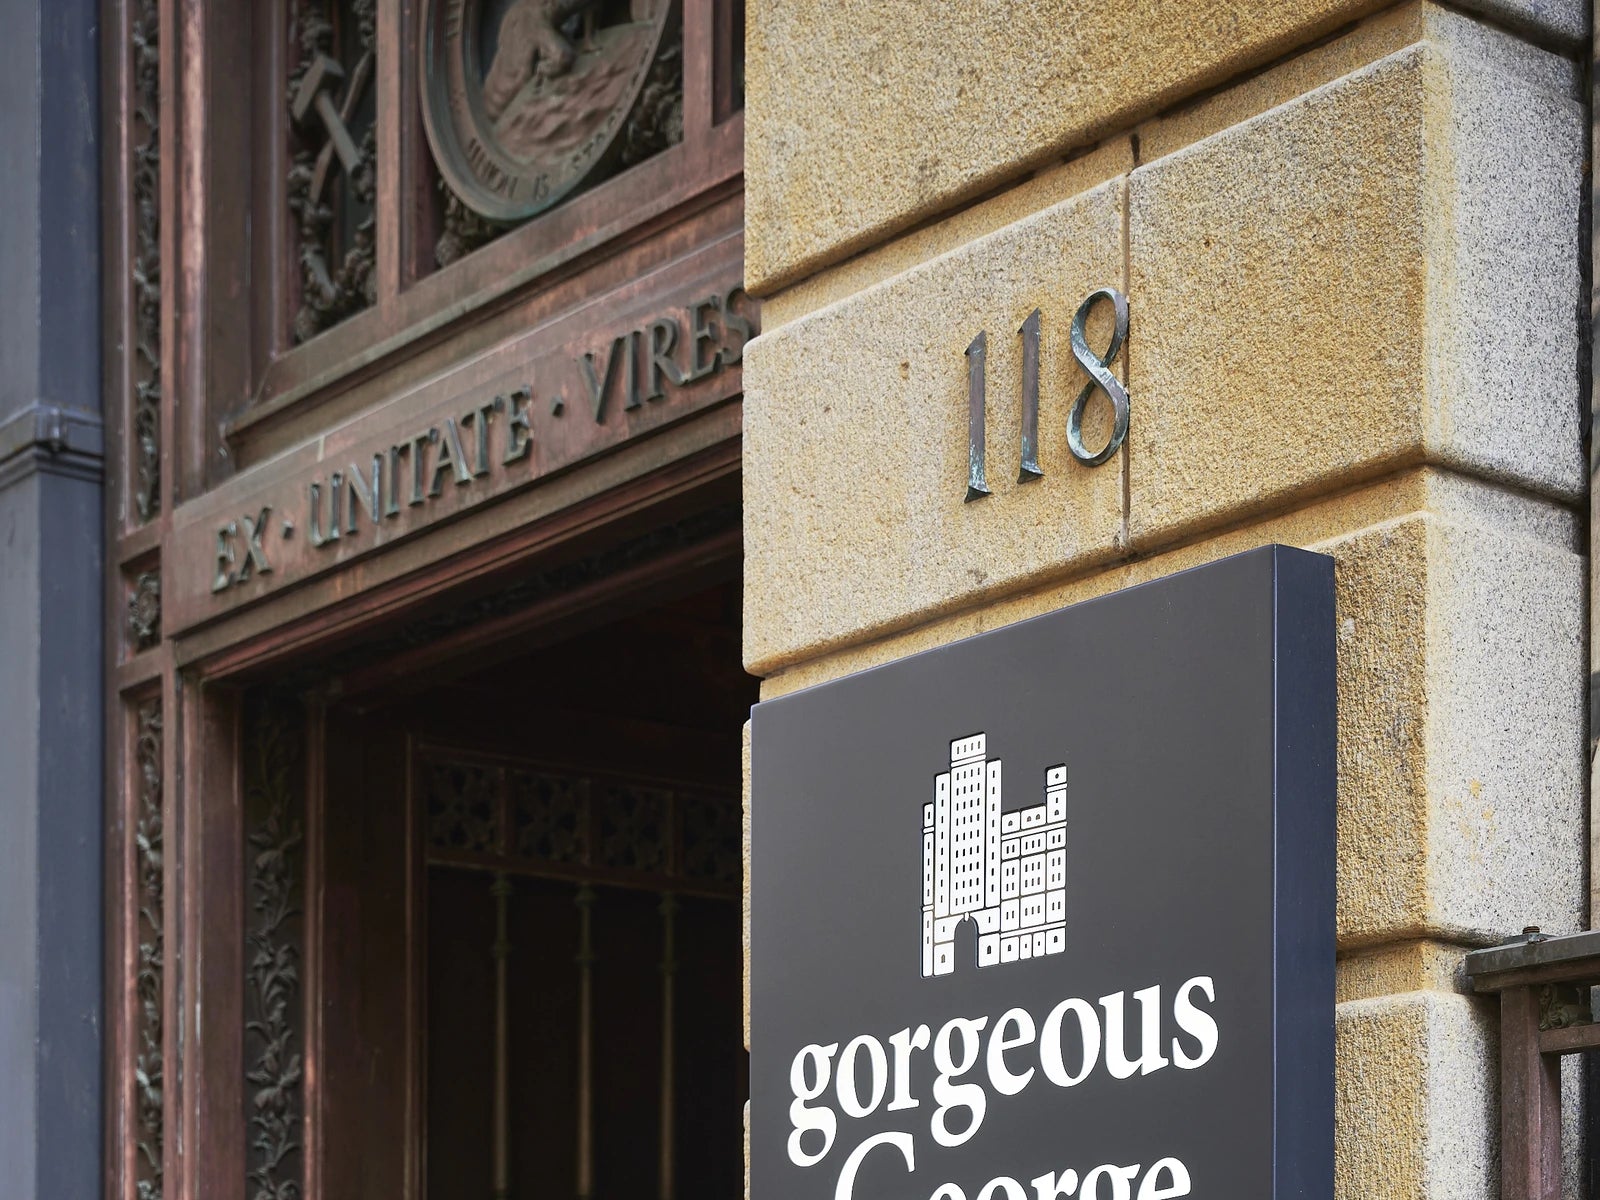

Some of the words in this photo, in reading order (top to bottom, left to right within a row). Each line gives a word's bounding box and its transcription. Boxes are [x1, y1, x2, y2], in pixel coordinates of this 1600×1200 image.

[211, 506, 273, 594] EX
[308, 384, 534, 549] UNITATE
[574, 281, 753, 425] VIRES
[964, 287, 1131, 504] 118
[787, 976, 1219, 1168] gorgeous
